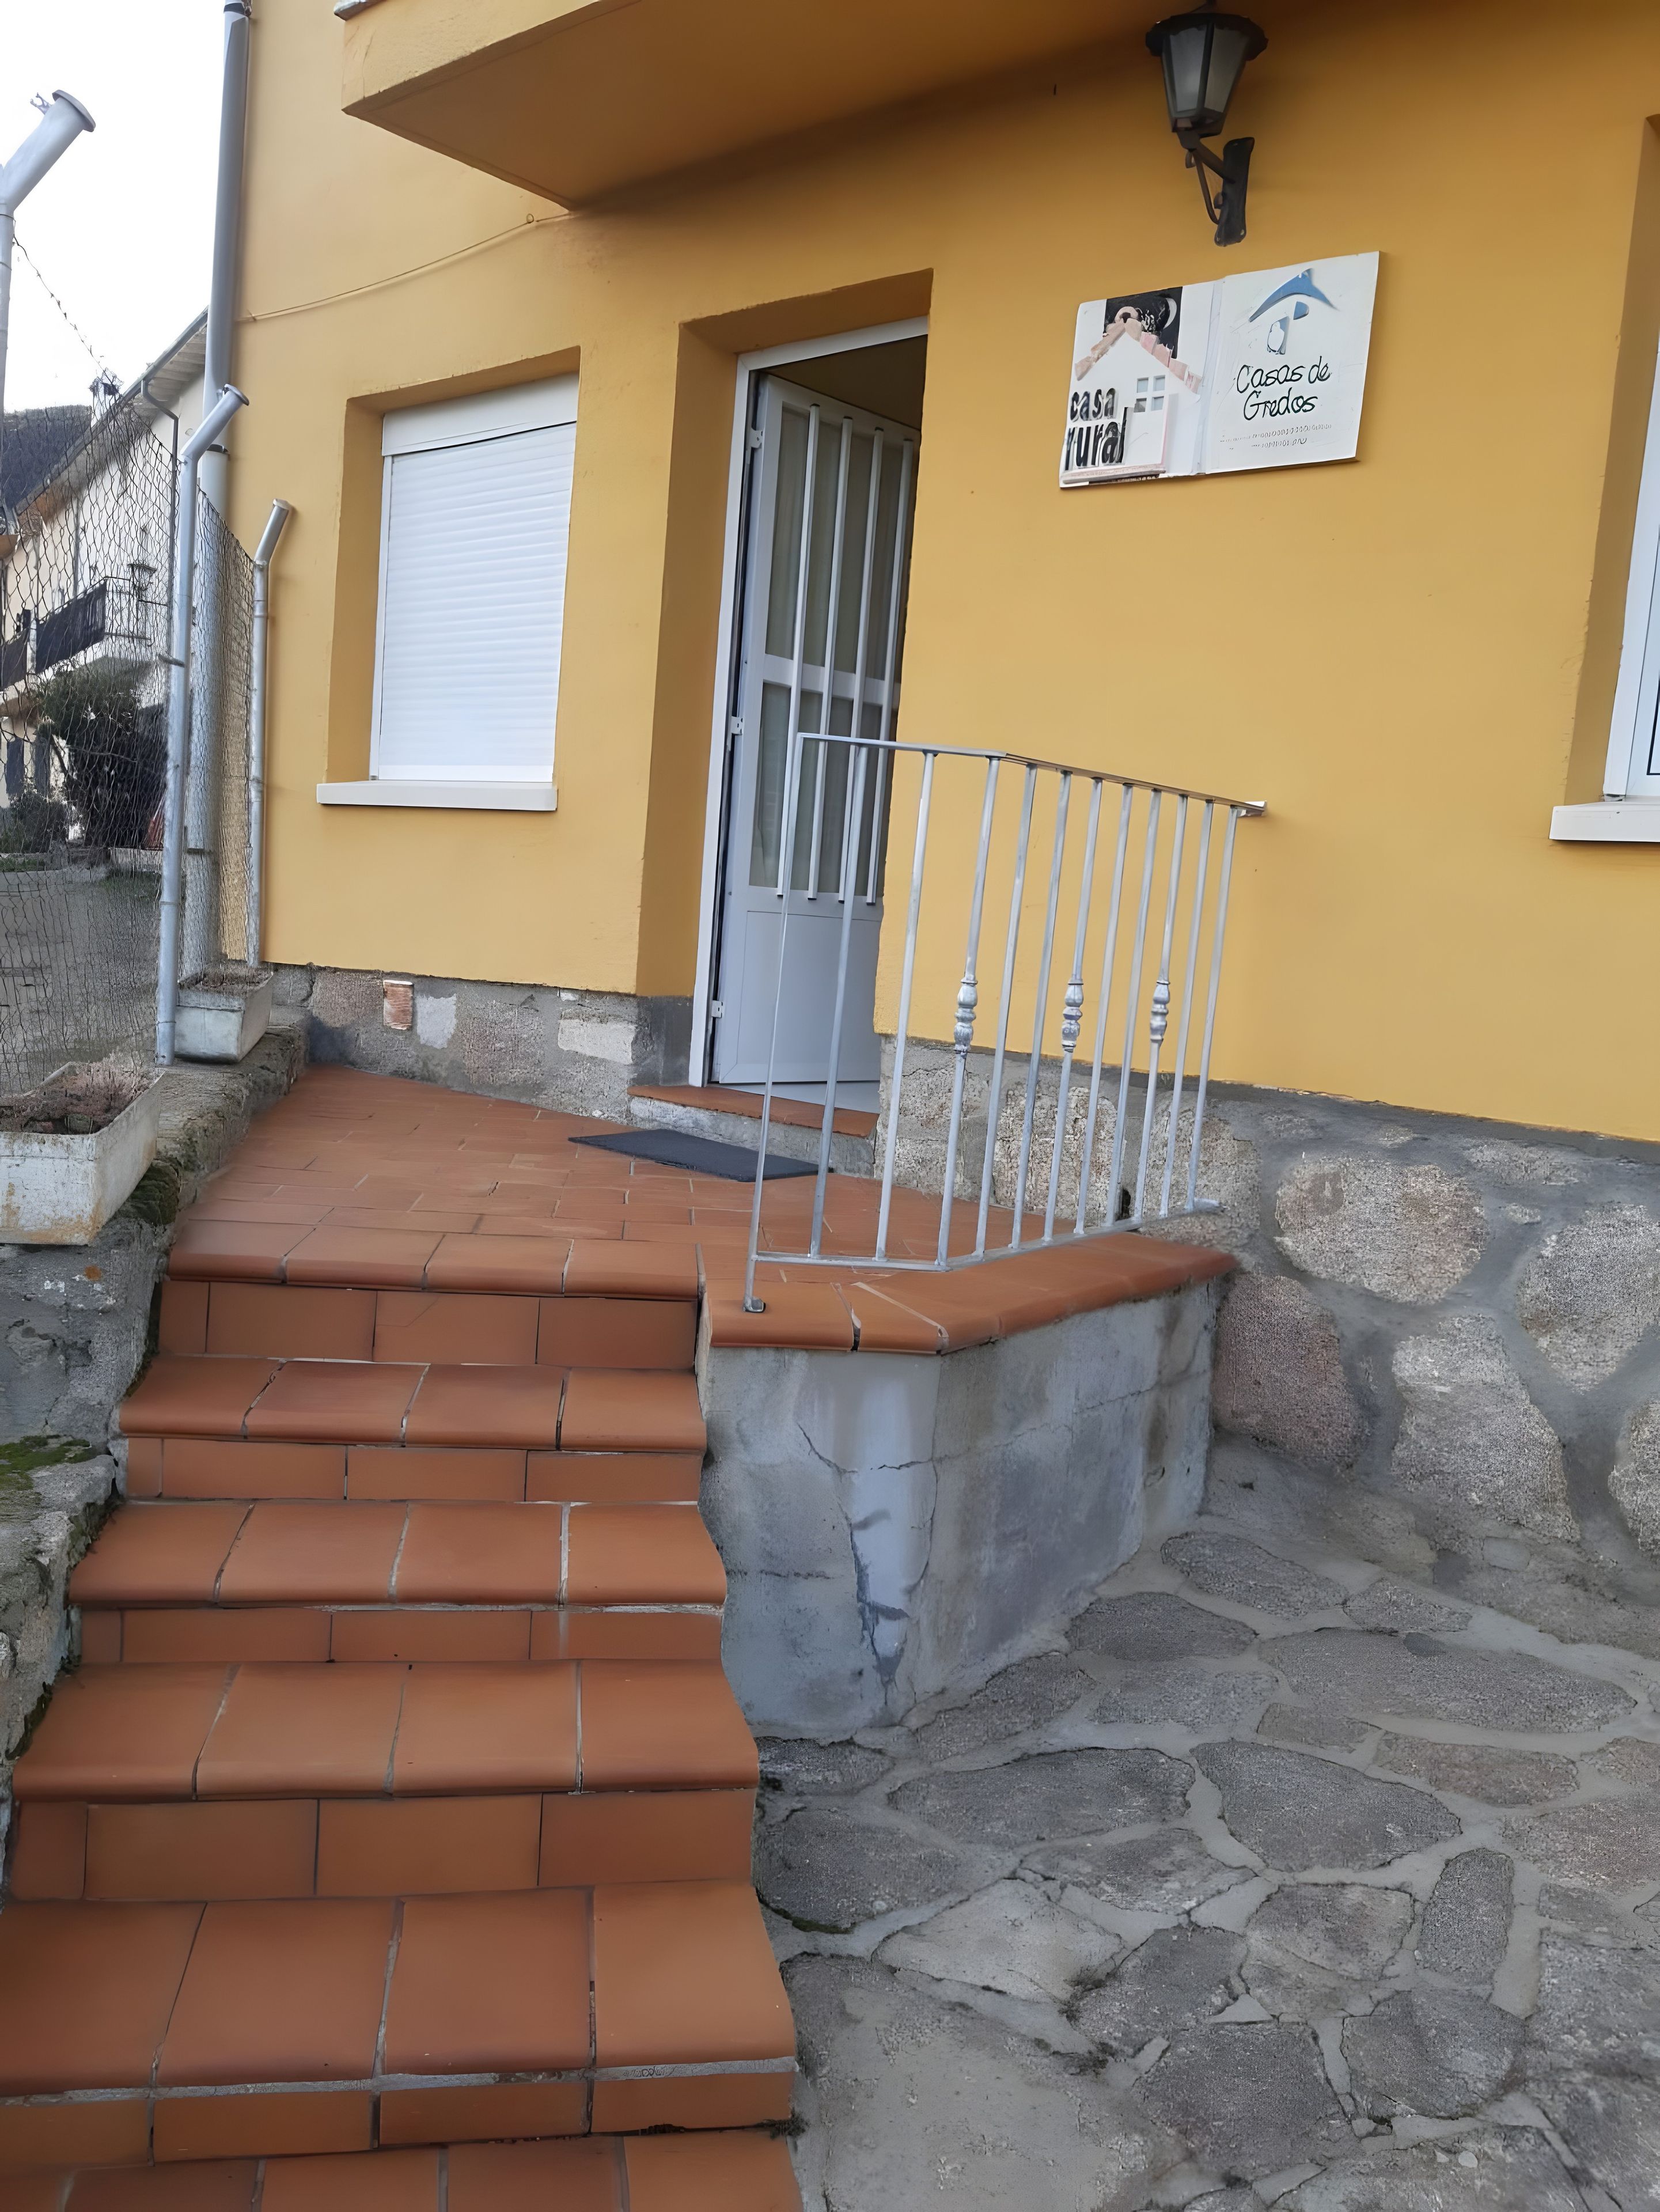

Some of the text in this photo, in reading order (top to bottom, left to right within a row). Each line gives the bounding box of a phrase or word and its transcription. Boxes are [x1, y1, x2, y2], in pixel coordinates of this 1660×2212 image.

[1236, 356, 1332, 394] Casas de
[1070, 388, 1117, 422] casa
[1243, 387, 1319, 421] Gredos
[1064, 407, 1128, 471] rural
